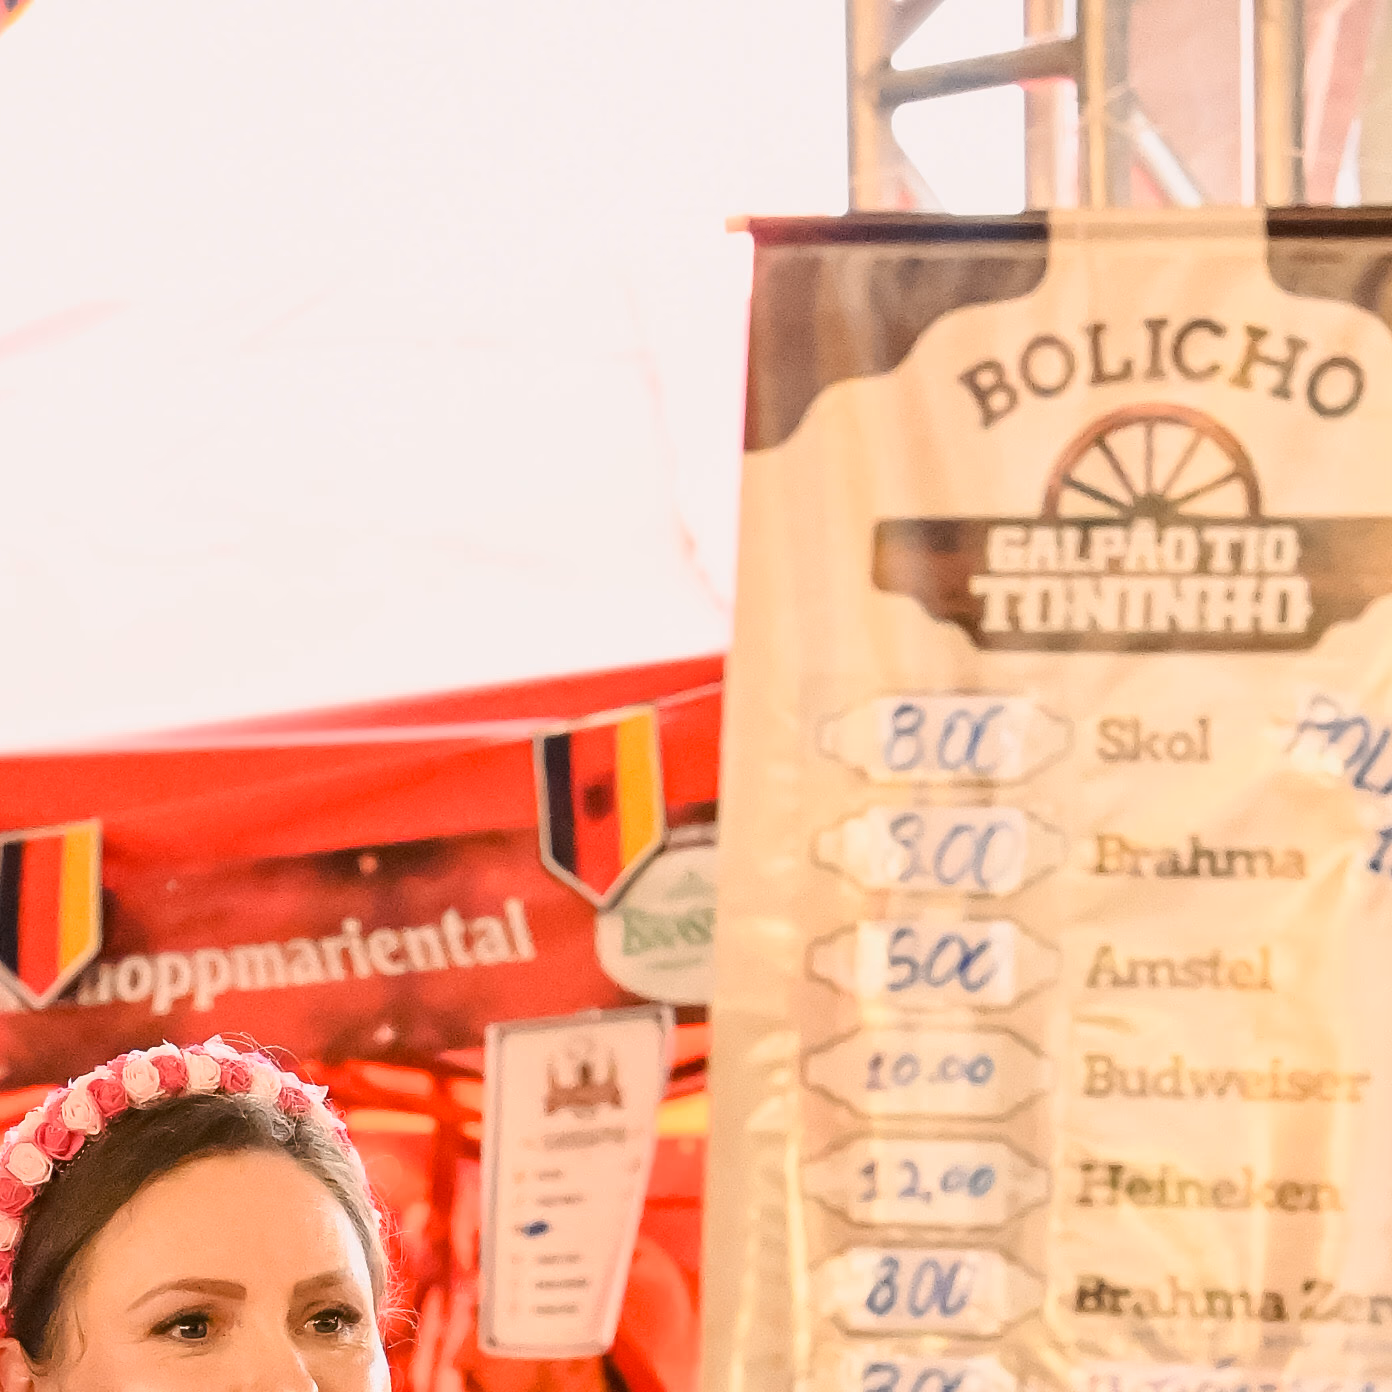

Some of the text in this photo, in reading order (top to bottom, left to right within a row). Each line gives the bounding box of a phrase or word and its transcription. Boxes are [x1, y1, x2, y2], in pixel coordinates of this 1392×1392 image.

[958, 317, 1365, 428] BOLICHO
[1200, 524, 1302, 574] TIO
[969, 574, 1313, 633] TONINHO
[1097, 715, 1212, 764] Skol
[1094, 833, 1307, 880] Brahma
[1086, 943, 1273, 992] Amstel
[1082, 1053, 1372, 1104] Budweiser
[1076, 1162, 1346, 1212] Heineken
[1075, 1275, 1290, 1322] Brahma
